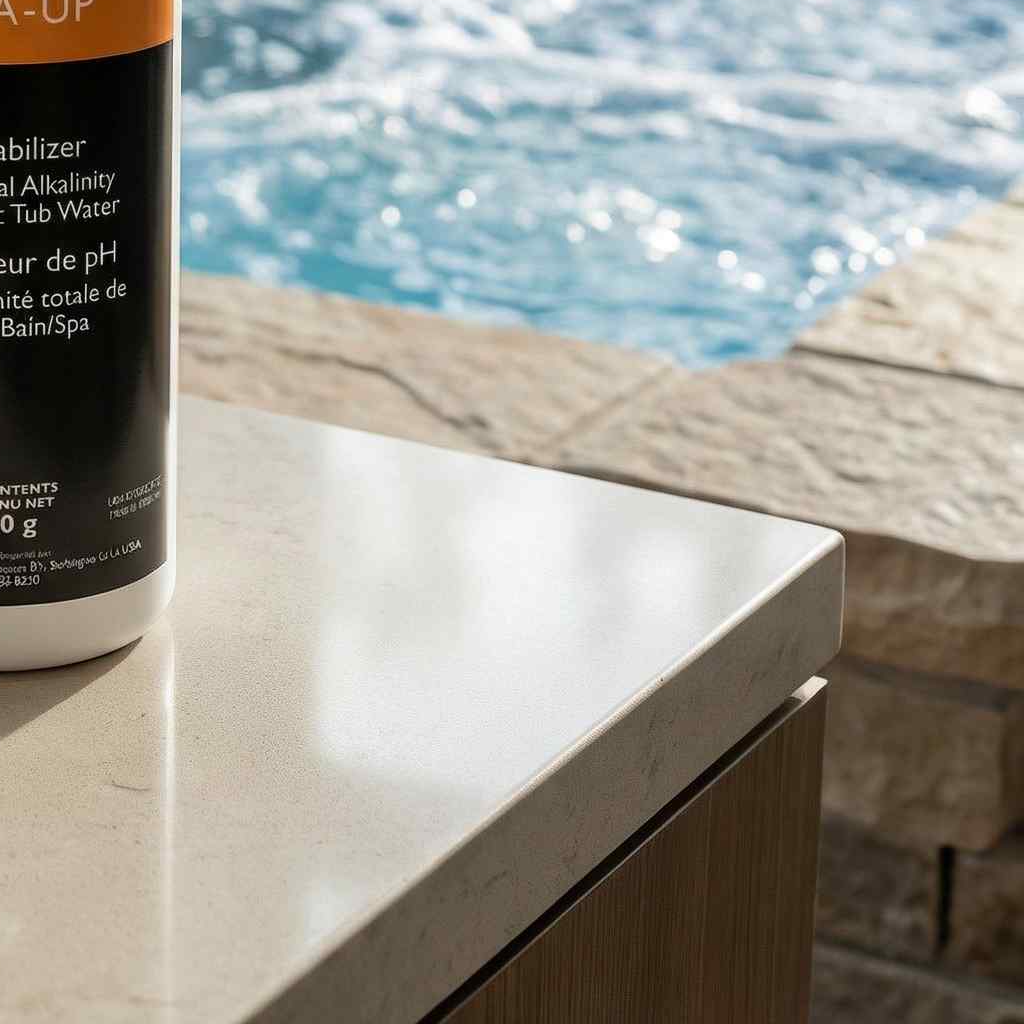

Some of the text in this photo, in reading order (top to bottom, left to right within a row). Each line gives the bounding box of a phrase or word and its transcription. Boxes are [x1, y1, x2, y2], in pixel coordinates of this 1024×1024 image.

[20, 170, 116, 197] Alkalinity
[9, 202, 52, 224] Tub
[56, 198, 120, 221] Water
[46, 247, 76, 272] de
[85, 239, 117, 276] pH
[40, 283, 100, 308] totale
[105, 278, 127, 299] de
[25, 496, 55, 509] NET
[22, 518, 38, 538] g
